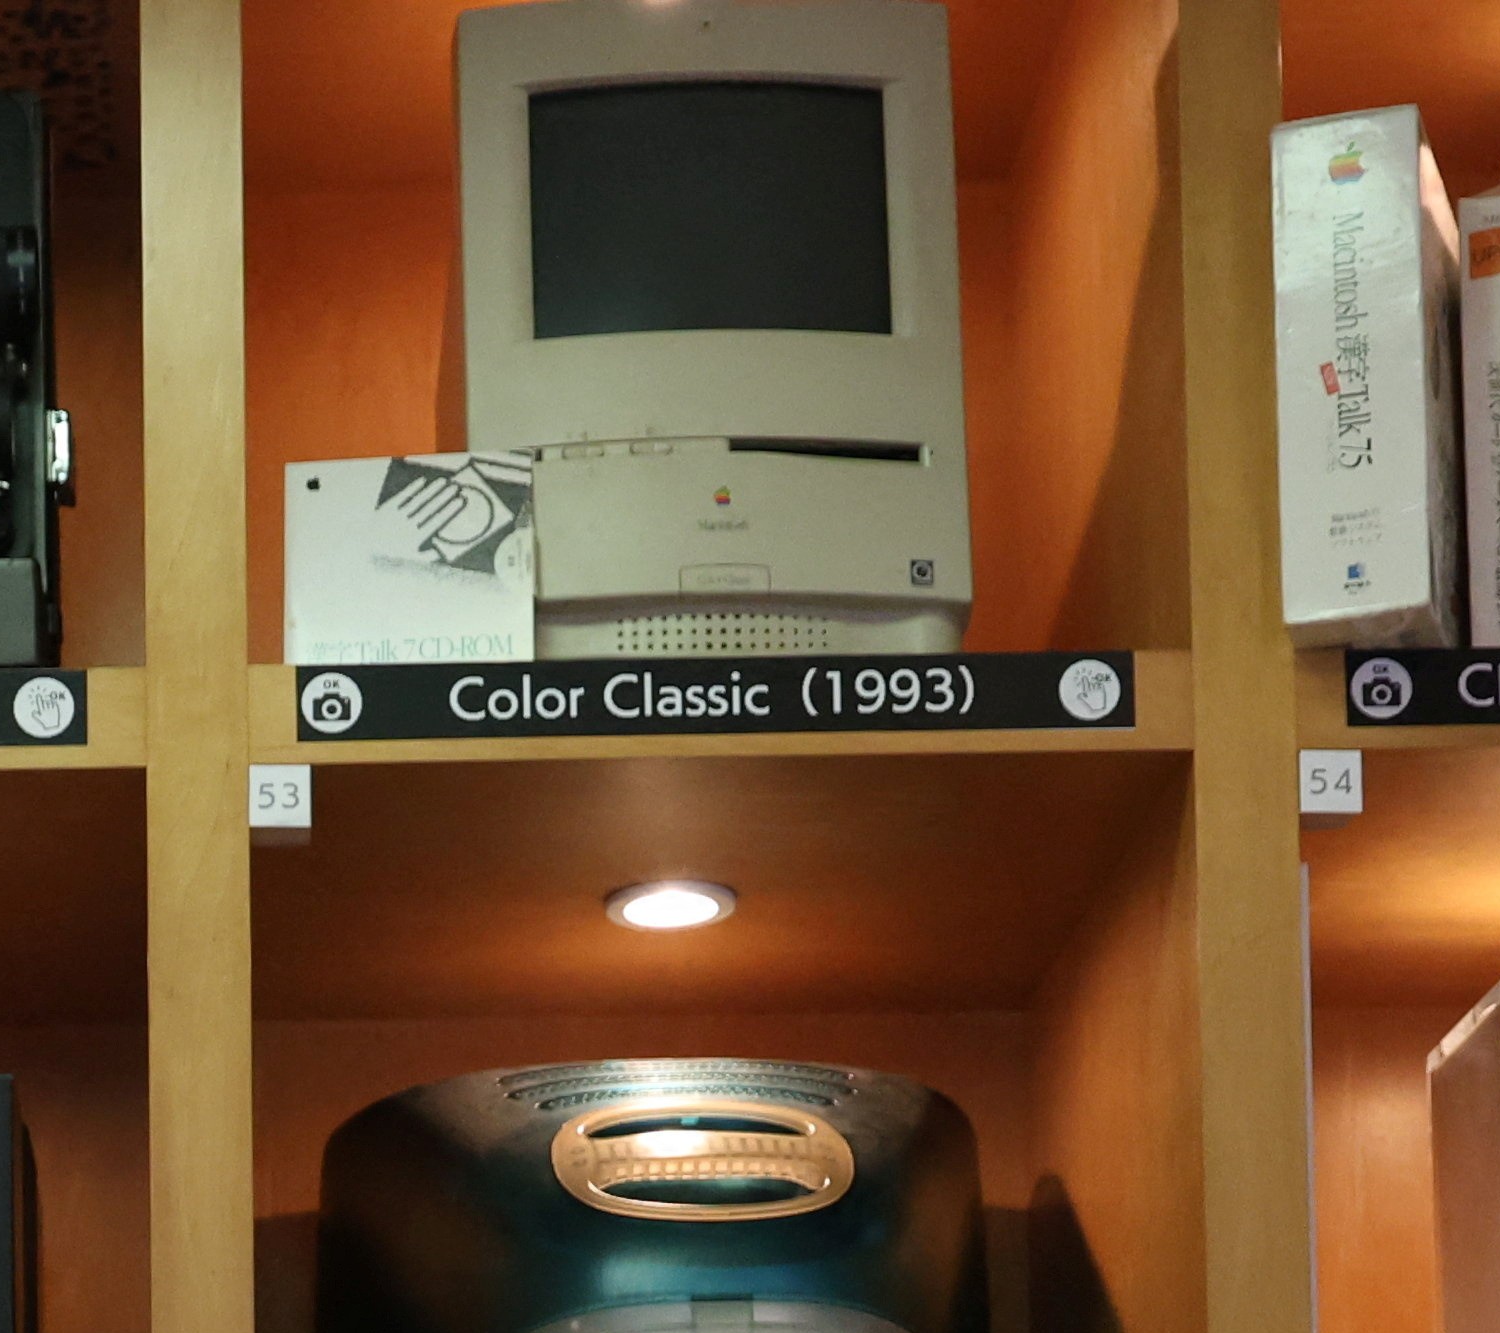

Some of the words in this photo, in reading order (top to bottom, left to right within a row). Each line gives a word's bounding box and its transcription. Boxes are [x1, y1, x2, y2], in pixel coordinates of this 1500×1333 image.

[1332, 212, 1369, 336] Macintosh
[403, 639, 418, 660] 7
[420, 633, 513, 661] CD-ROM
[449, 673, 585, 722] Color
[602, 670, 771, 719] Classic
[801, 663, 976, 717] (1993)
[1310, 767, 1353, 795] 54
[257, 783, 301, 808] 53
